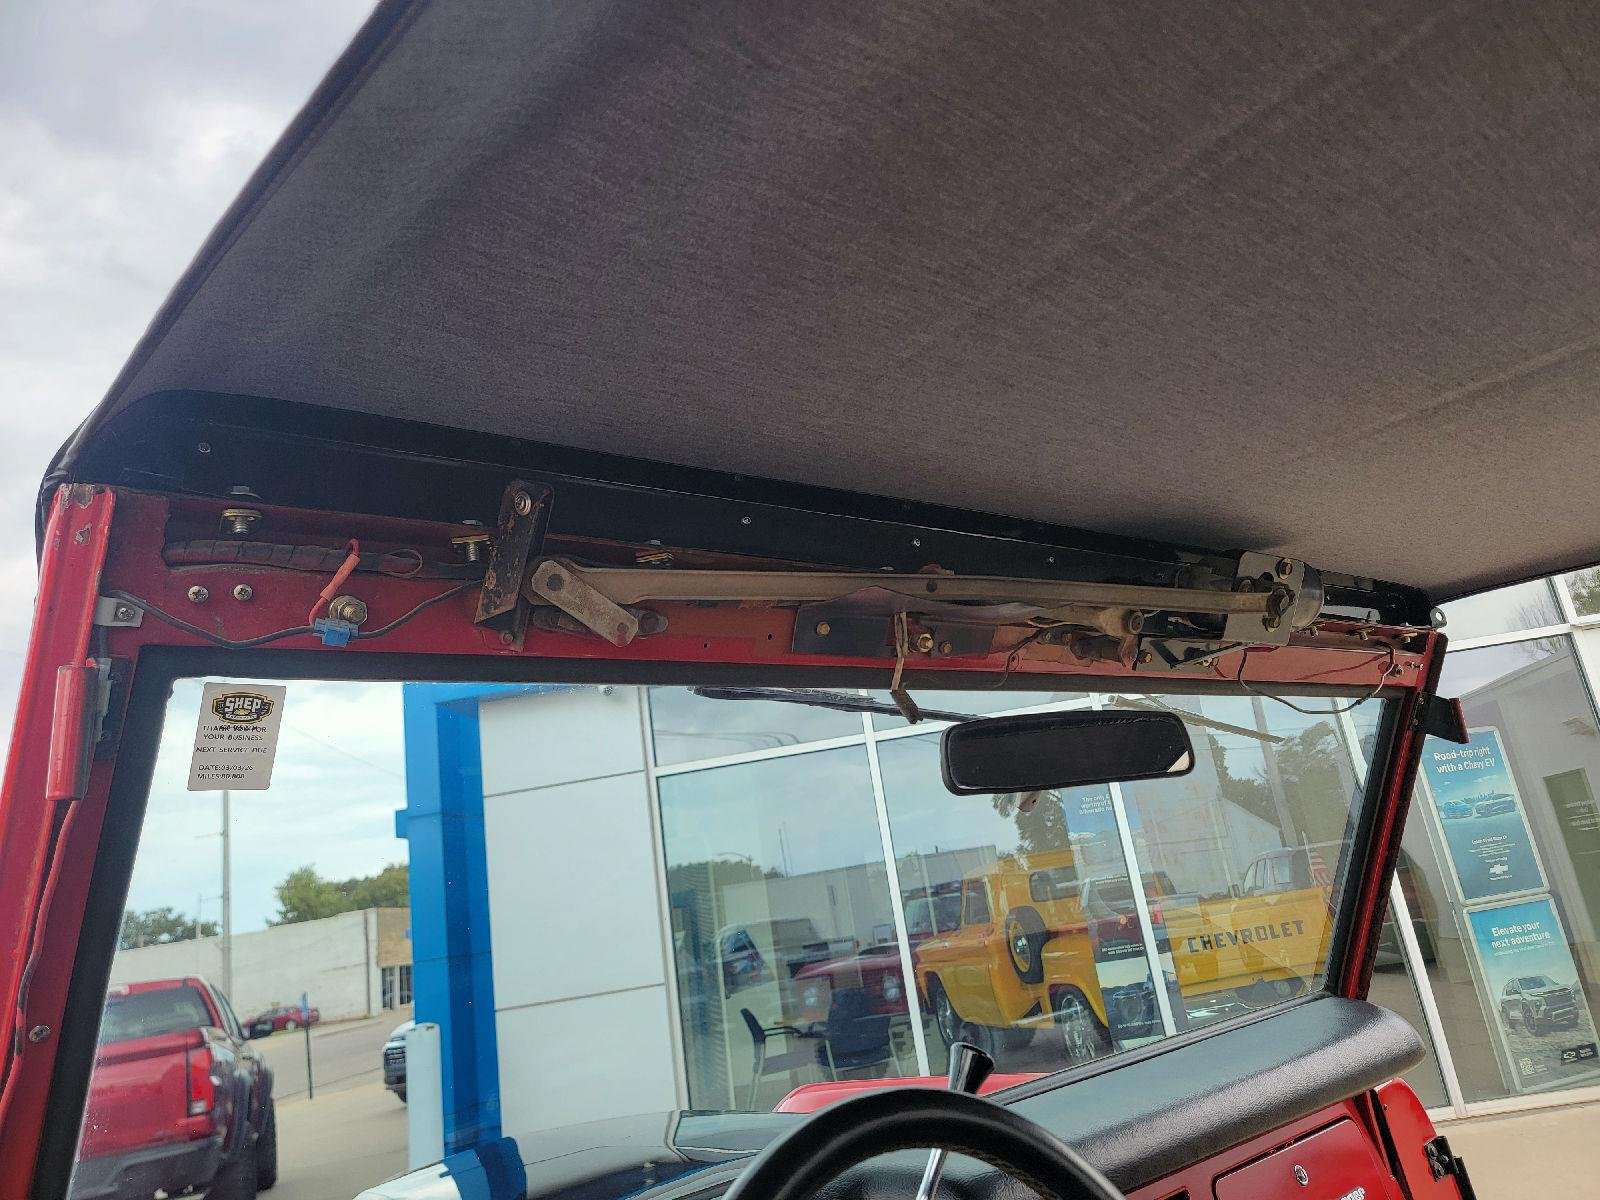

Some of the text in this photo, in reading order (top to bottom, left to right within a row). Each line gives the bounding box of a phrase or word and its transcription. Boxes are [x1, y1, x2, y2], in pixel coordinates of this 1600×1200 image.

[225, 698, 262, 712] SHEP
[1433, 746, 1491, 761] Road-trip right
[1436, 757, 1495, 773] with a Chevy EV
[1187, 920, 1304, 953] CHEVROLET
[1491, 921, 1540, 937] Elevate your
[1491, 931, 1551, 949] next adventure
